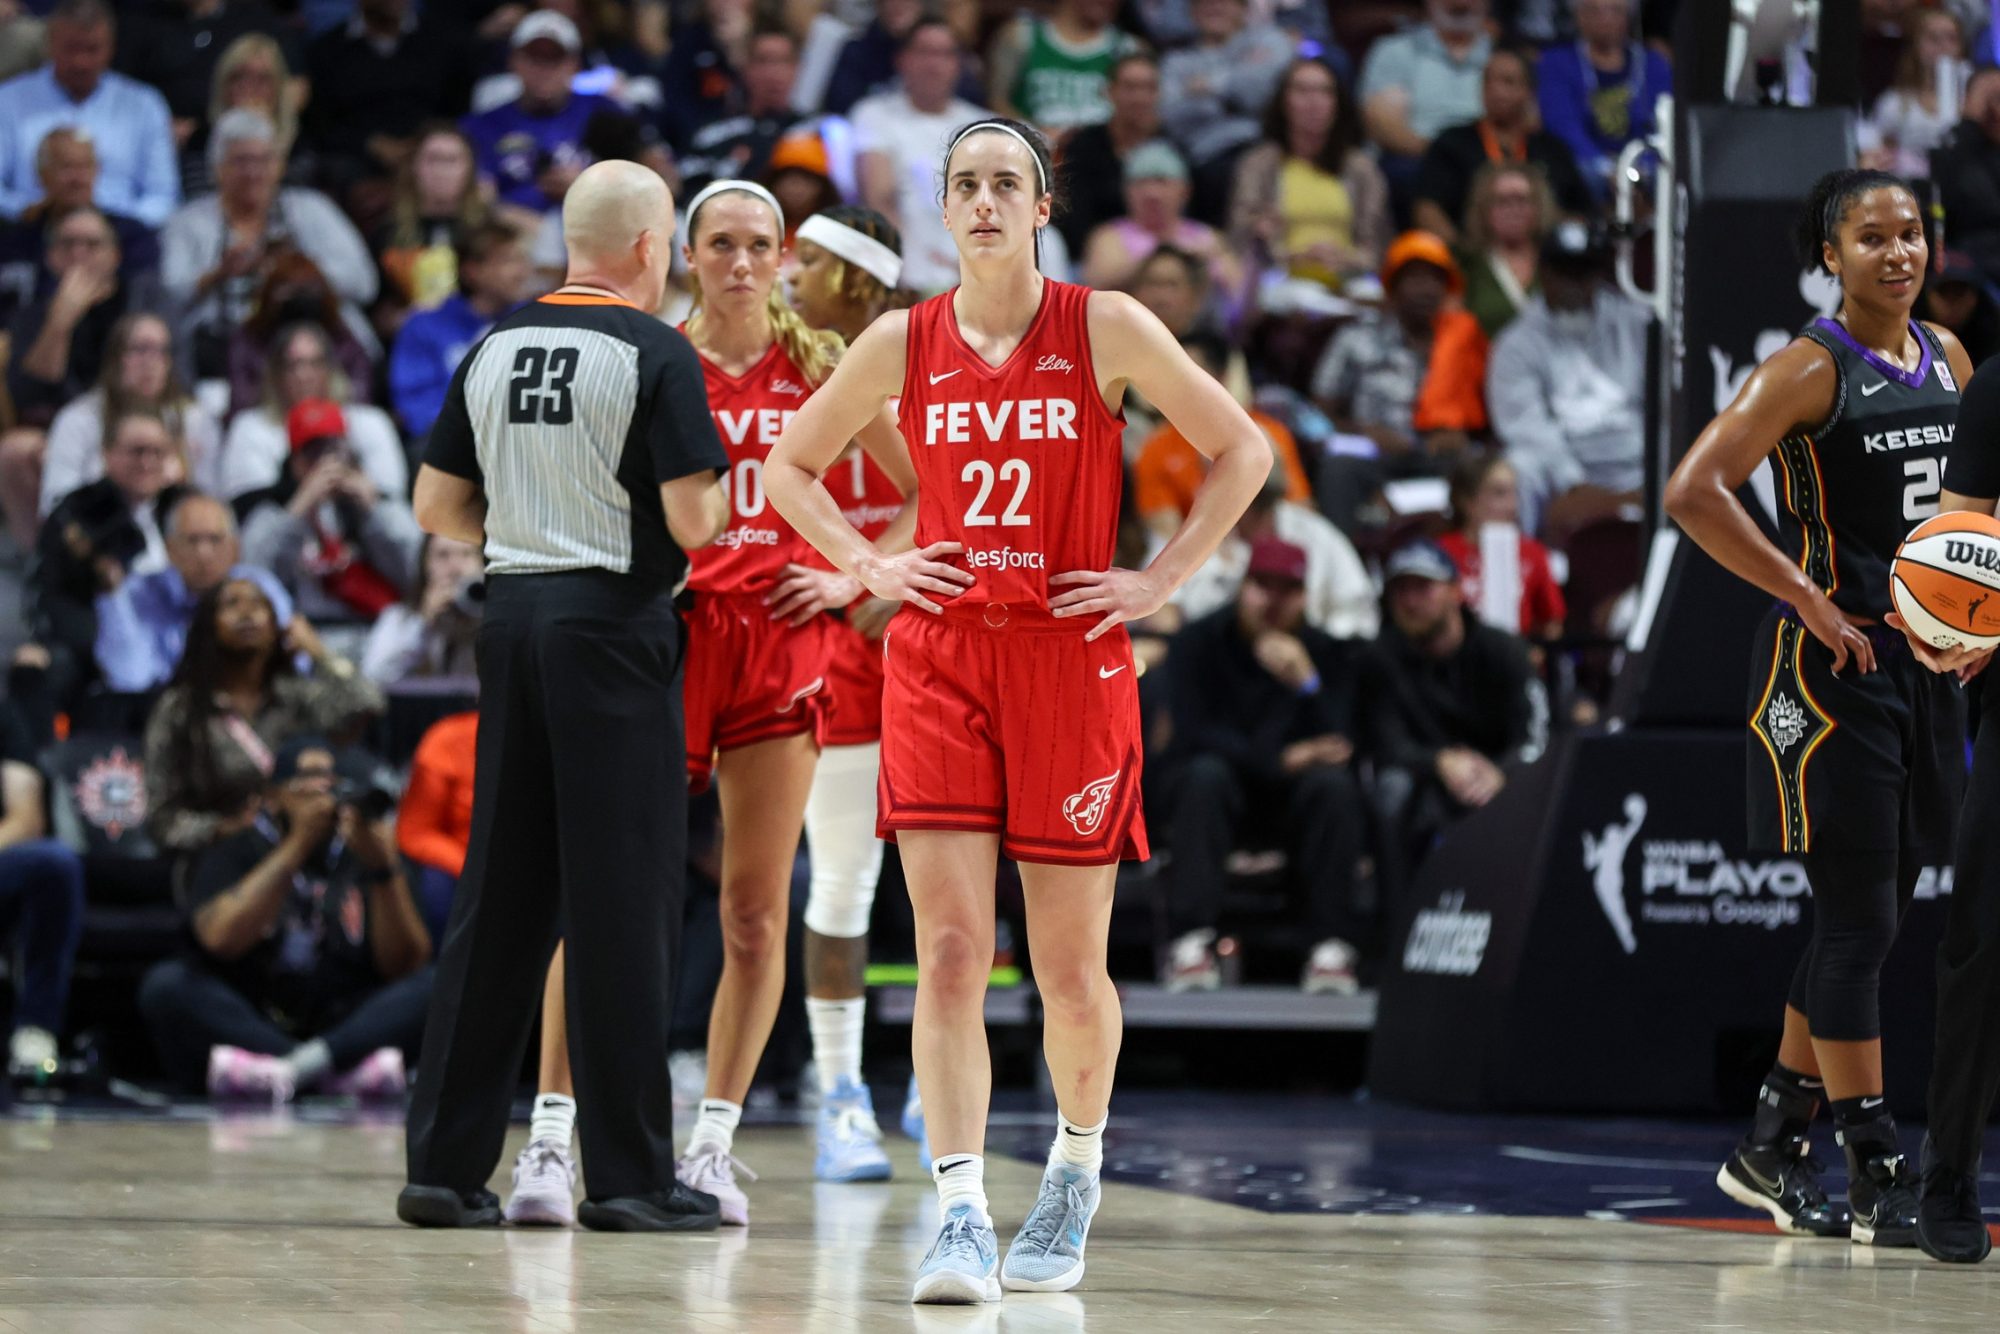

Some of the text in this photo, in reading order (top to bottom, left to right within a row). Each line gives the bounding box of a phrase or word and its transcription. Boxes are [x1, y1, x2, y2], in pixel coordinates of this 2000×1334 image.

[1034, 354, 1074, 375] Lilly
[508, 347, 580, 425] 23
[710, 408, 799, 446] VE
[925, 398, 1079, 445] FEVER
[1863, 423, 1956, 454] KEESU
[720, 458, 766, 518] 0
[961, 458, 1031, 527] 22
[1903, 456, 1949, 521] 2
[714, 524, 780, 551] esforce
[1642, 860, 1812, 897] PLAYO
